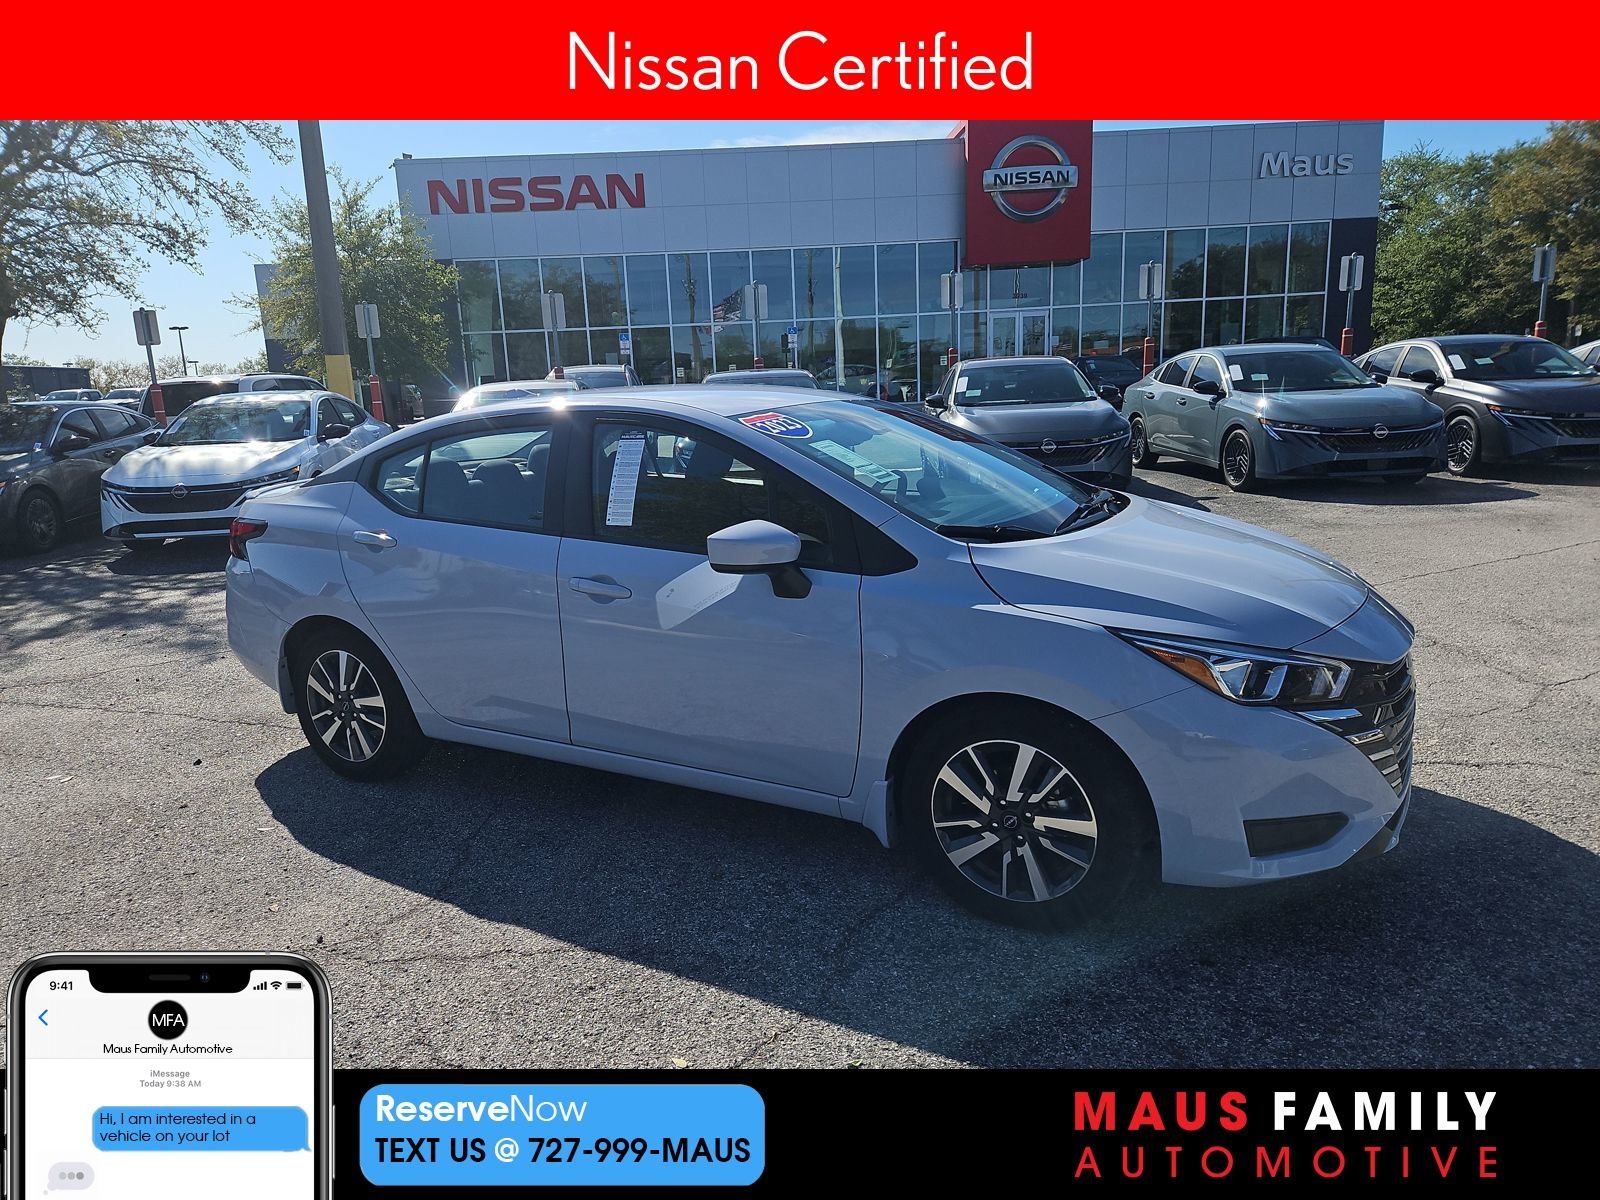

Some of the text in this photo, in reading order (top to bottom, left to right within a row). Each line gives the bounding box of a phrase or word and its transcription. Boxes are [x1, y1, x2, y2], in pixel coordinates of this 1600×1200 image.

[1259, 151, 1354, 178] Maus
[993, 170, 1070, 187] NISSAN
[427, 173, 646, 215] NISSAN
[756, 418, 803, 434] 2023
